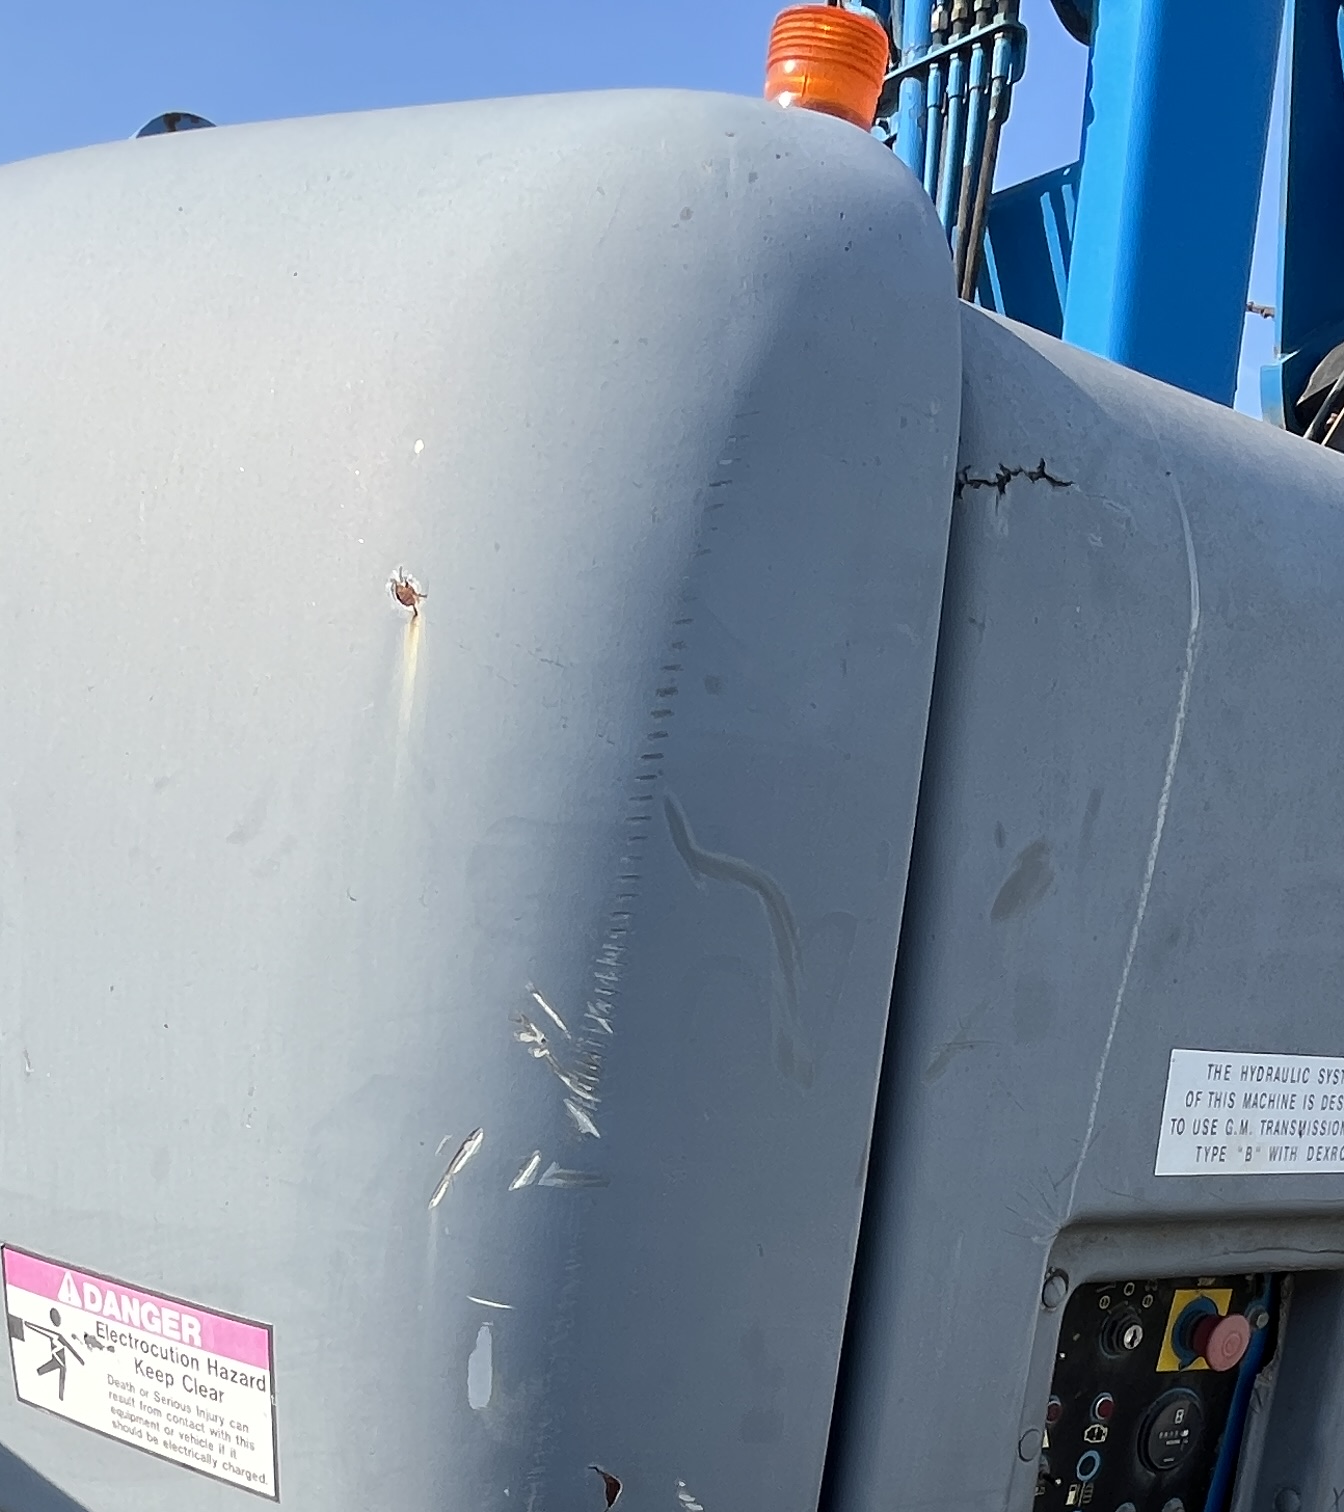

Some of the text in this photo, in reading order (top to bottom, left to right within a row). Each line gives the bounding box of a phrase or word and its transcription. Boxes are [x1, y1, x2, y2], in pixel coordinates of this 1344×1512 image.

[1208, 1064, 1232, 1080] THE
[1240, 1065, 1310, 1084] HYDRAULIC
[1186, 1090, 1203, 1108] OF
[1208, 1092, 1236, 1108] THIS
[1242, 1092, 1297, 1110] MACHINE
[1302, 1094, 1315, 1110] IS
[1170, 1118, 1186, 1136] TO
[1192, 1118, 1218, 1136] USE
[1226, 1118, 1253, 1136] G.M.
[1196, 1146, 1227, 1162] TYPE
[1269, 1146, 1298, 1162] WITH
[83, 1282, 202, 1348] DANGER
[96, 1320, 266, 1392] Electrocution Hazard
[107, 1374, 249, 1434] Death or Serious Injury can
[134, 1358, 224, 1404] Keep Clear
[109, 1391, 255, 1452] result from contact with this
[111, 1406, 160, 1432] equipment
[164, 1426, 174, 1436] or
[179, 1432, 214, 1452] vehicle
[112, 1420, 142, 1439] should
[146, 1431, 159, 1446] be
[163, 1440, 218, 1469] electrically
